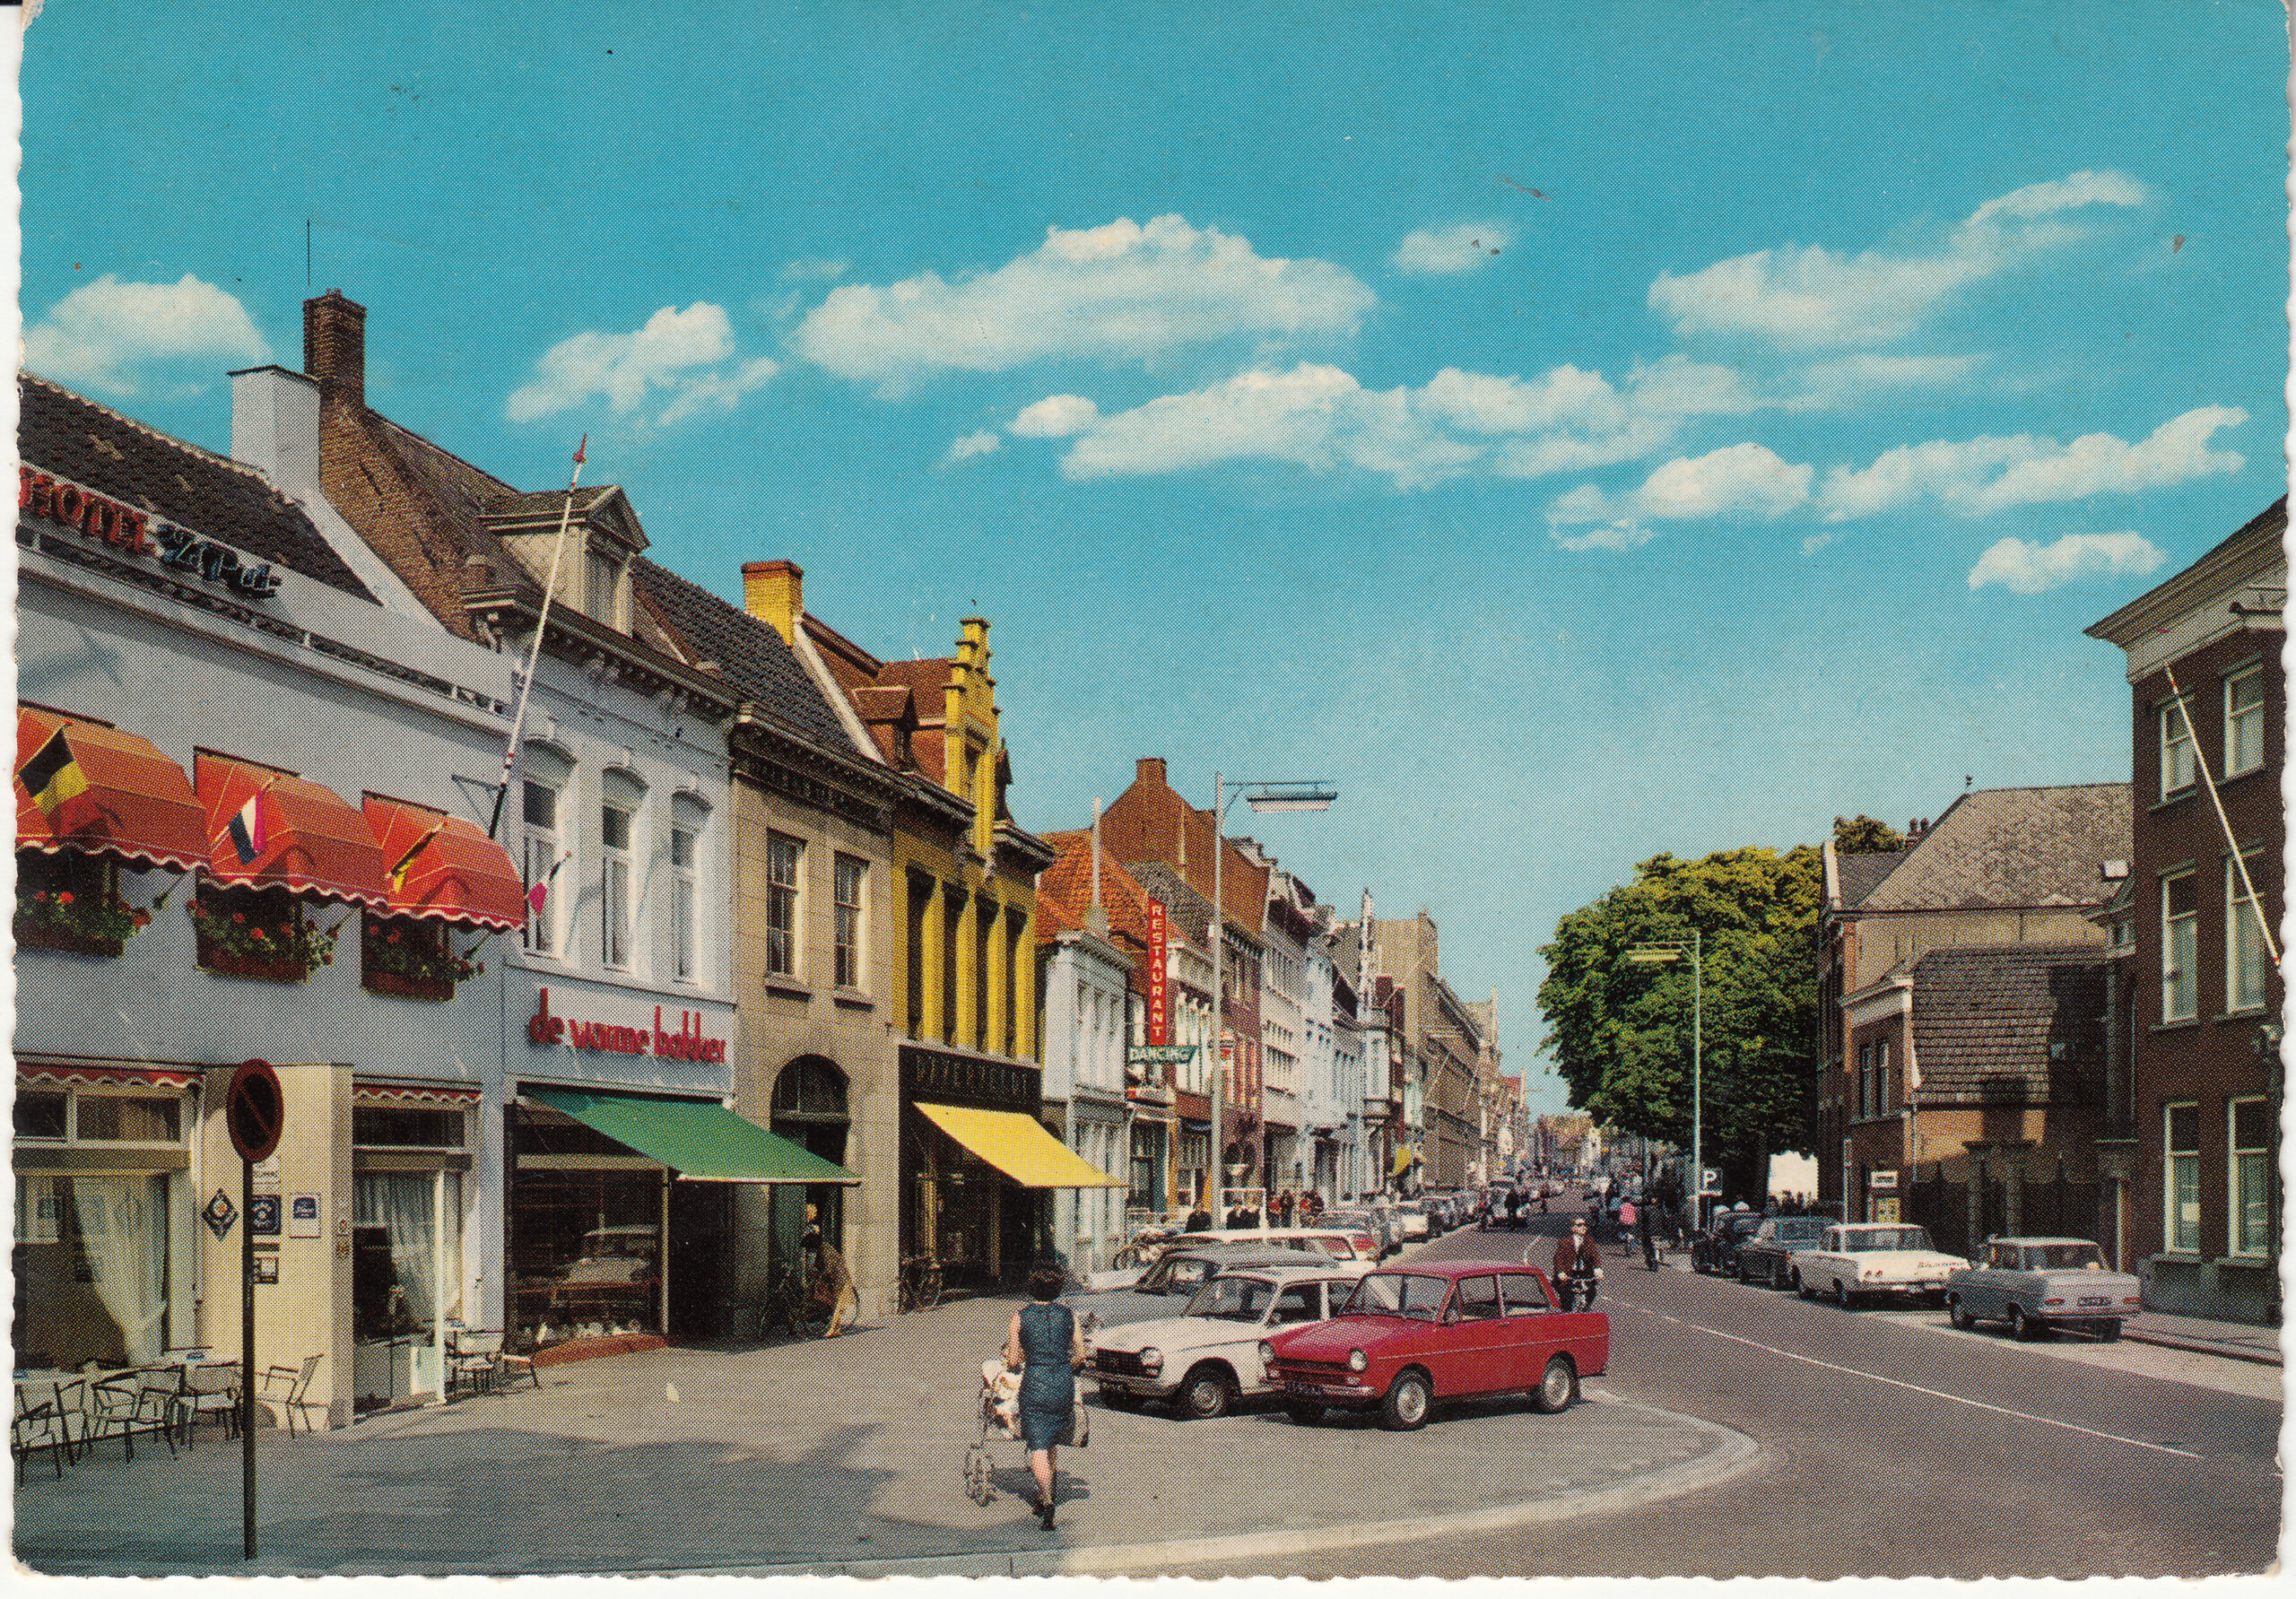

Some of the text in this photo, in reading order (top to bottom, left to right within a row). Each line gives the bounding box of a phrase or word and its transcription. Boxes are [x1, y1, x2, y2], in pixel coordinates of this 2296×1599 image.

[19, 466, 156, 556] HOTEL
[1152, 905, 1163, 1038] RESTAURANT
[527, 987, 726, 1064] de warme bakker
[1128, 1047, 1190, 1062] DANCING
[1703, 1170, 1718, 1189] P
